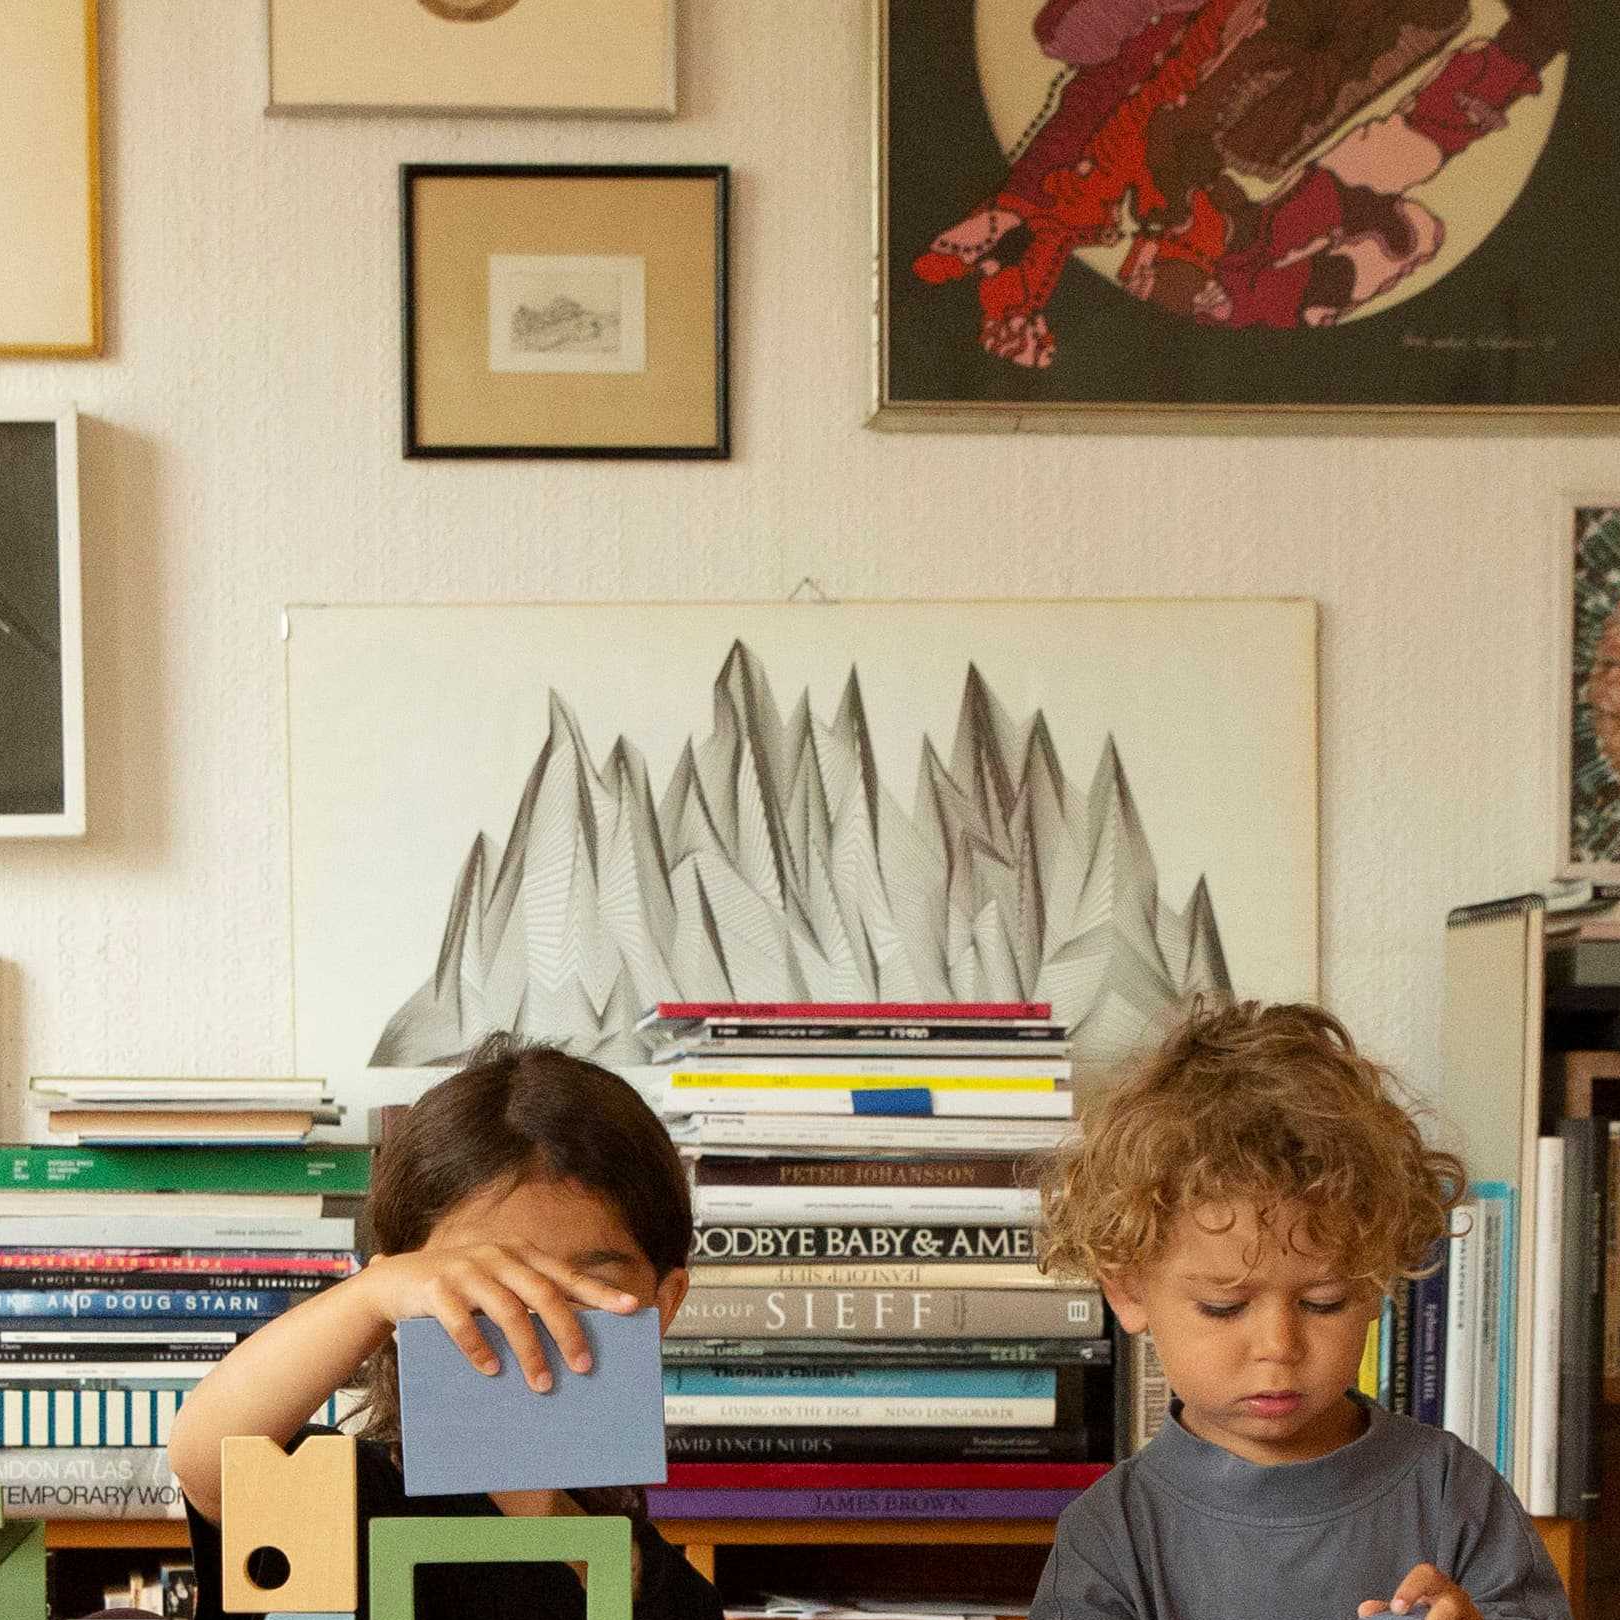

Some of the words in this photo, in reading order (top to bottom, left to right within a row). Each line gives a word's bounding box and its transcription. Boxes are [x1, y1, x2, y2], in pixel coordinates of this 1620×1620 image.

[779, 1167, 848, 1183] PETER
[855, 1167, 976, 1183] JOHANSSON
[692, 1227, 816, 1256] ODBYE
[826, 1227, 909, 1256] BABY
[911, 1228, 943, 1256] &
[948, 1227, 1036, 1256] AME
[209, 1277, 251, 1288] TOBIAS
[48, 1293, 92, 1310] AND
[106, 1294, 171, 1310] DOUG
[185, 1294, 259, 1311] STARN
[765, 1292, 934, 1330] SIEFF
[716, 1438, 770, 1451] LYNCH
[776, 1438, 833, 1451] NUDES
[62, 1459, 132, 1480] ATLAS
